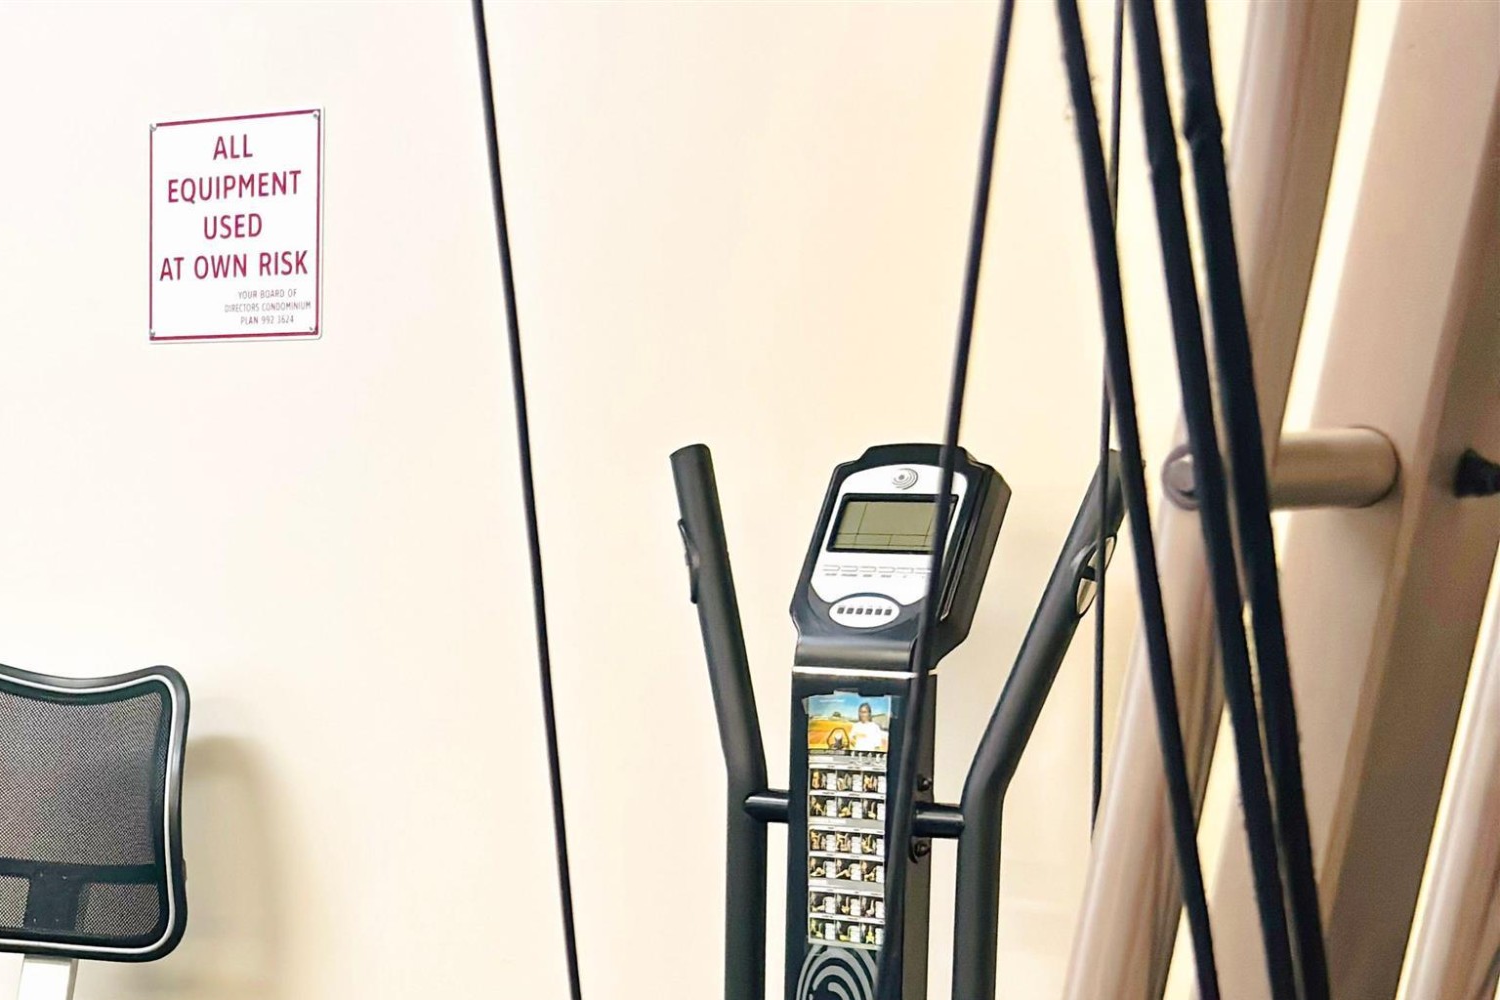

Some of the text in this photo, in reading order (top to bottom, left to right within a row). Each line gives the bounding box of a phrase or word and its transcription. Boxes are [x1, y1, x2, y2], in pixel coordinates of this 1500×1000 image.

[213, 134, 253, 160] ALL
[168, 170, 302, 204] EQUIPMENT
[204, 213, 263, 240] USED
[160, 250, 308, 281] AT OWN RISK
[224, 301, 312, 313] DIRECTORS CONDOMINIUM
[238, 288, 298, 300] YOUR BOARD OF
[240, 316, 259, 325] PLAN
